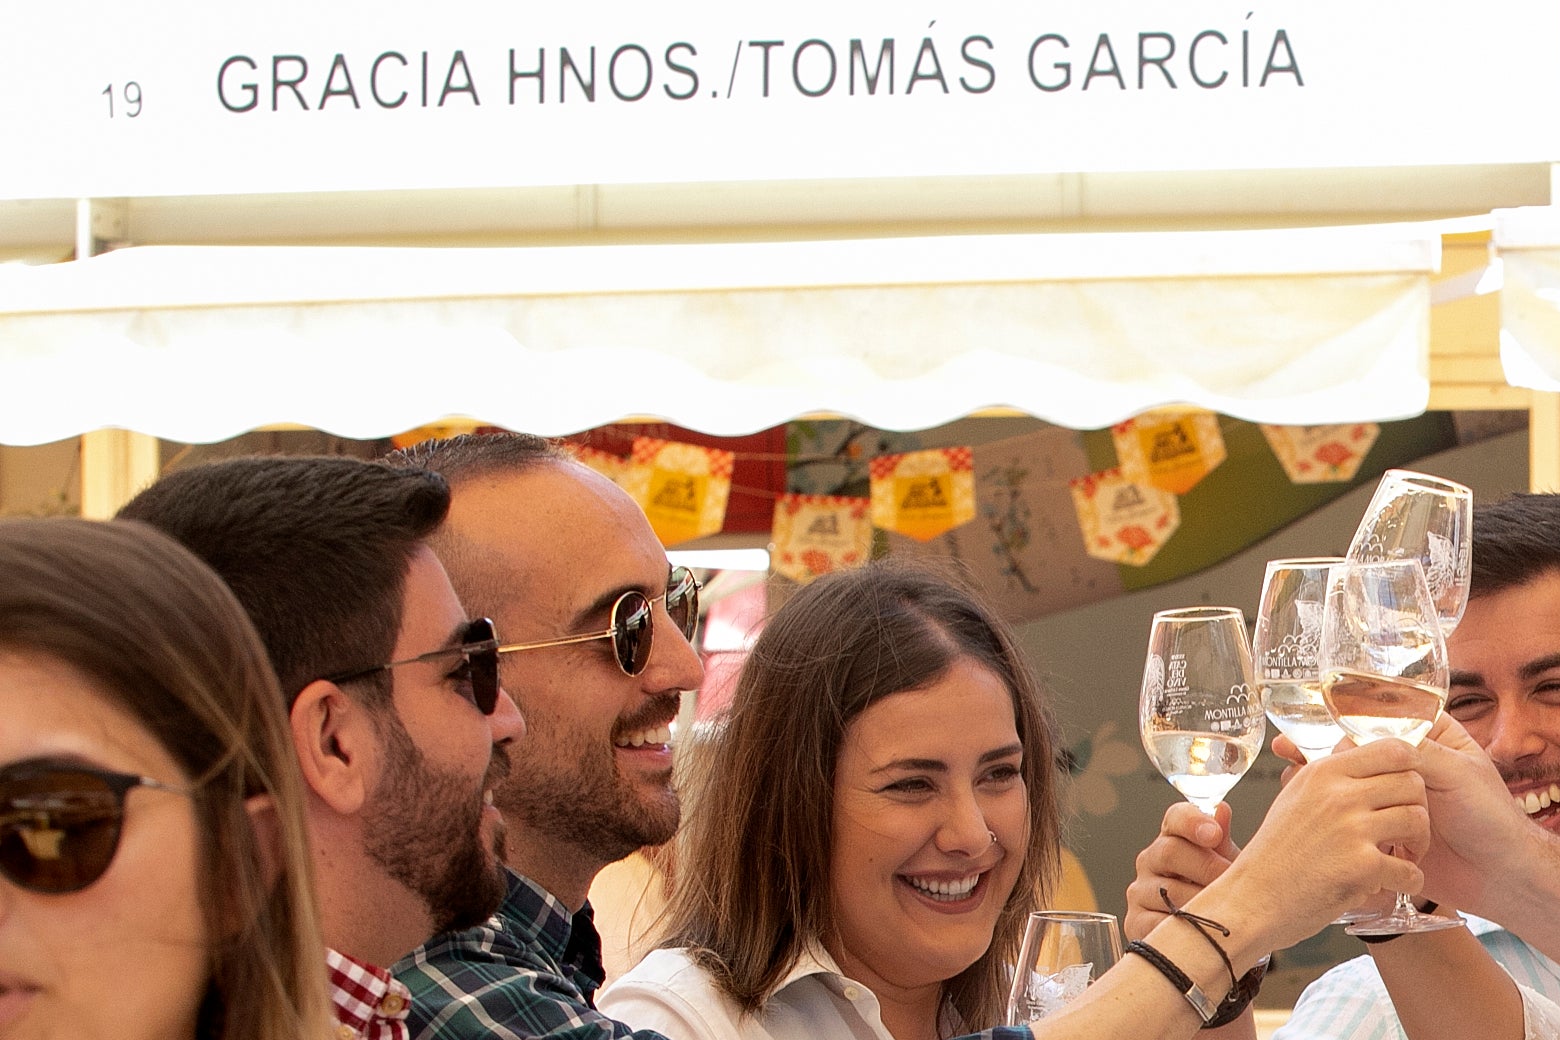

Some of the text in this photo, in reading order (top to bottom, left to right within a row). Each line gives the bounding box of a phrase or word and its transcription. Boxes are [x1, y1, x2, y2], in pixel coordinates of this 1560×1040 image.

[216, 11, 1305, 113] GRACIA HNOS./TOMÁS GARCÍA
[102, 82, 143, 118] 19
[1204, 707, 1247, 721] MONTILLA
